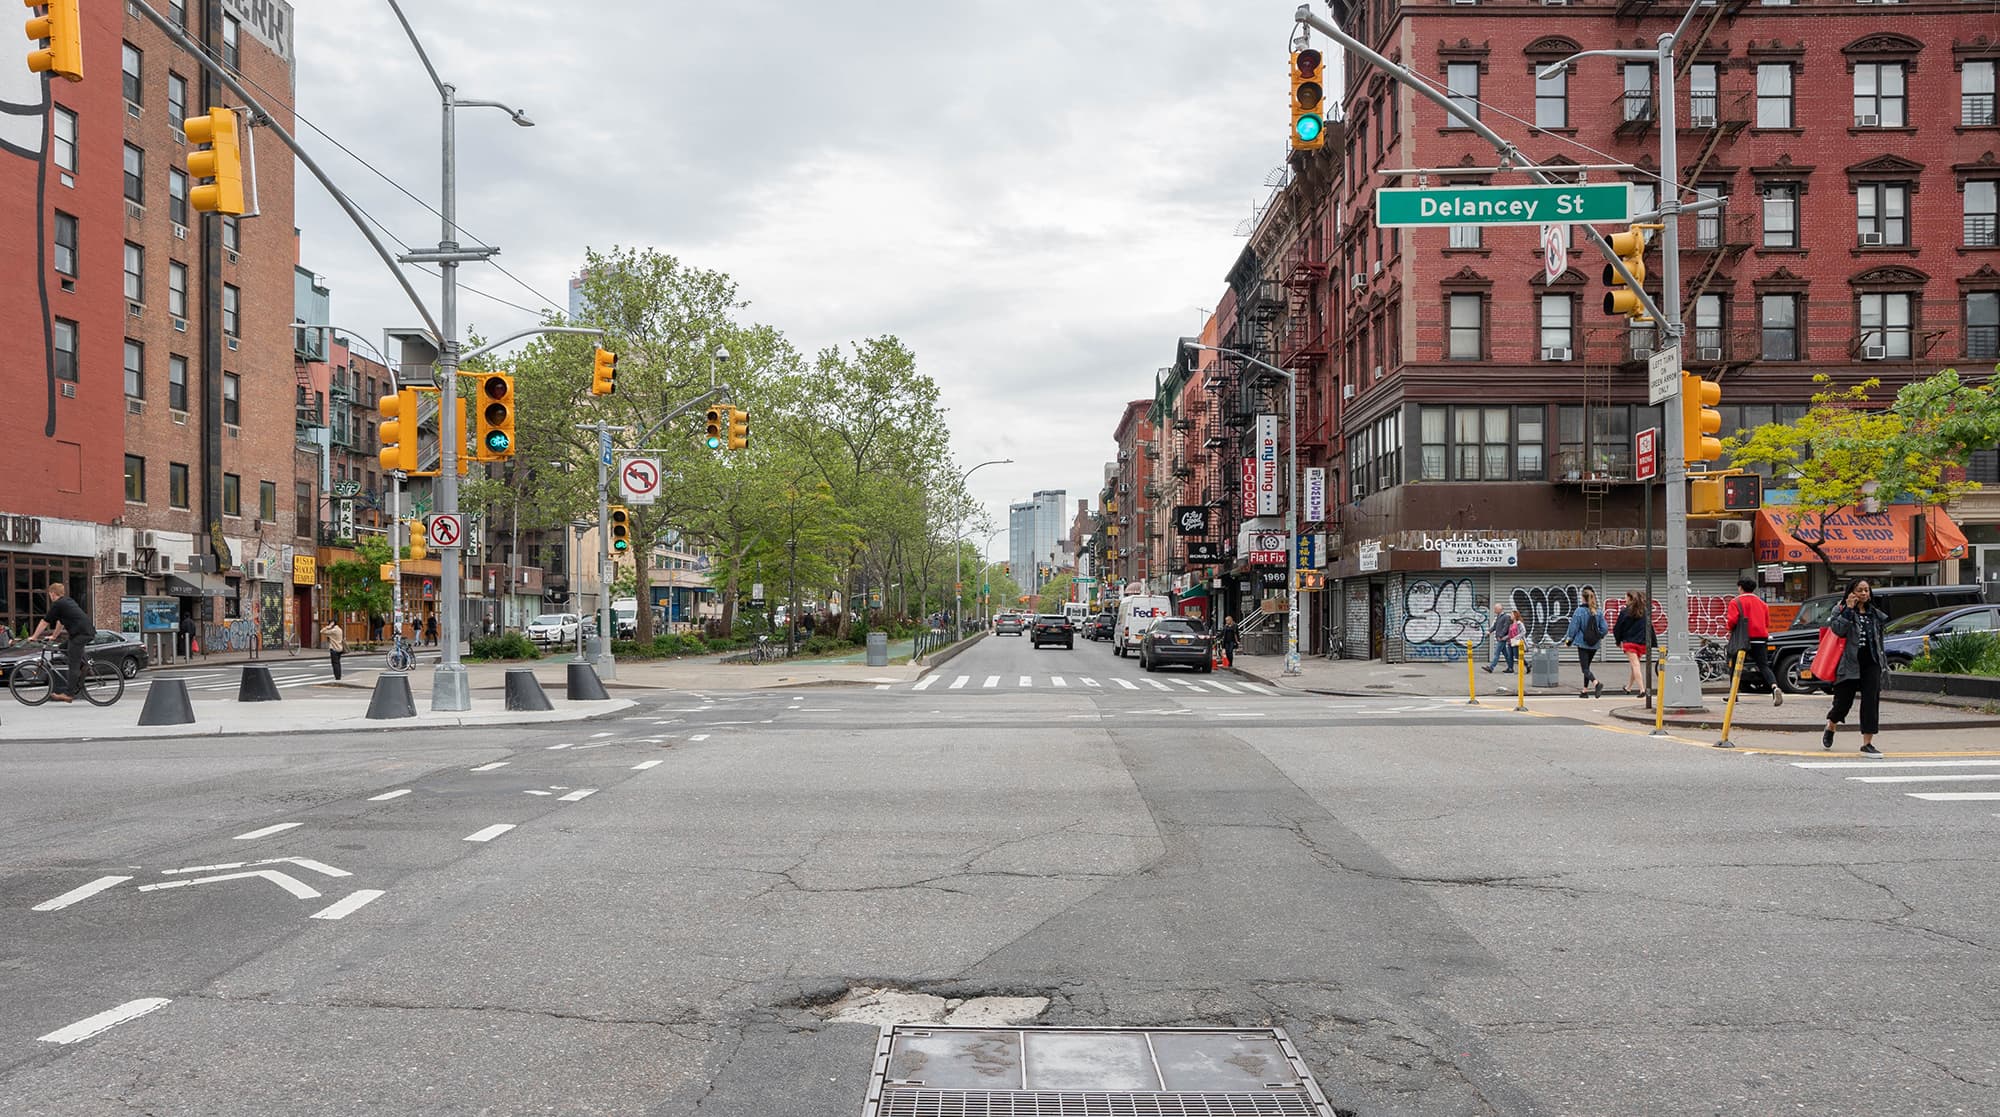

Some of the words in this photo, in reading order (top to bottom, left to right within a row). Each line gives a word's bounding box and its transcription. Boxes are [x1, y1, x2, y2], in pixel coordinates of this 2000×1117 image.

[1420, 196, 1539, 220] Delancey
[1556, 193, 1585, 214] St
[1652, 359, 1663, 370] LEFT
[1660, 367, 1667, 376] ON
[1663, 371, 1677, 383] ARROW
[1658, 385, 1669, 395] ONLY
[1261, 438, 1276, 492] anything
[1243, 457, 1256, 517] LIQUORS
[1770, 513, 1783, 526] N
[1852, 528, 1895, 541] SHOP
[1444, 541, 1473, 549] PRIME
[1250, 552, 1268, 562] Flat
[1270, 552, 1285, 562] Fix
[1760, 549, 1779, 561] ATM
[1263, 572, 1286, 581] 1969
[1133, 607, 1167, 618] FedEx
